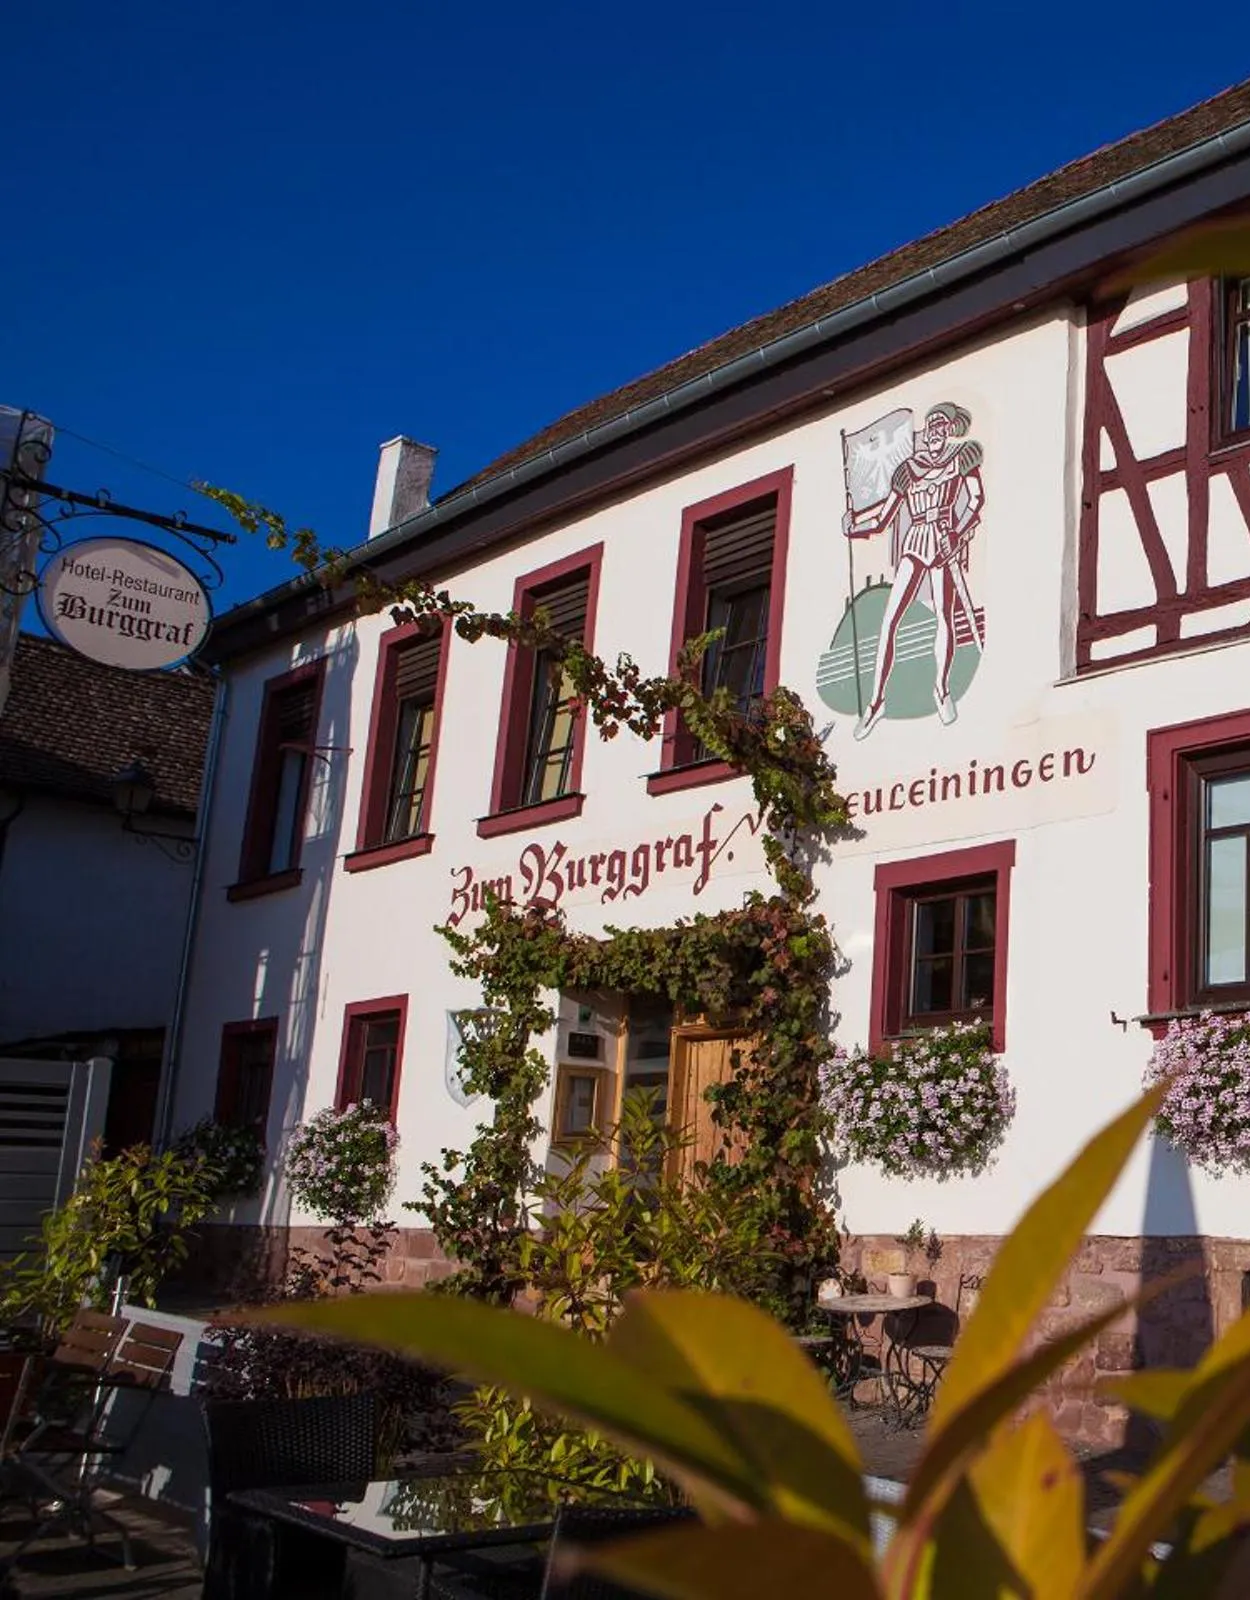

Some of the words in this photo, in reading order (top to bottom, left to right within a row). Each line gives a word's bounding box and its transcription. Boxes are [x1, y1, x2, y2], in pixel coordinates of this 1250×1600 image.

[61, 557, 200, 605] Hotel-Restaurant
[106, 588, 152, 614] Zum
[57, 592, 193, 646] Burggraf
[446, 866, 513, 927] Zum
